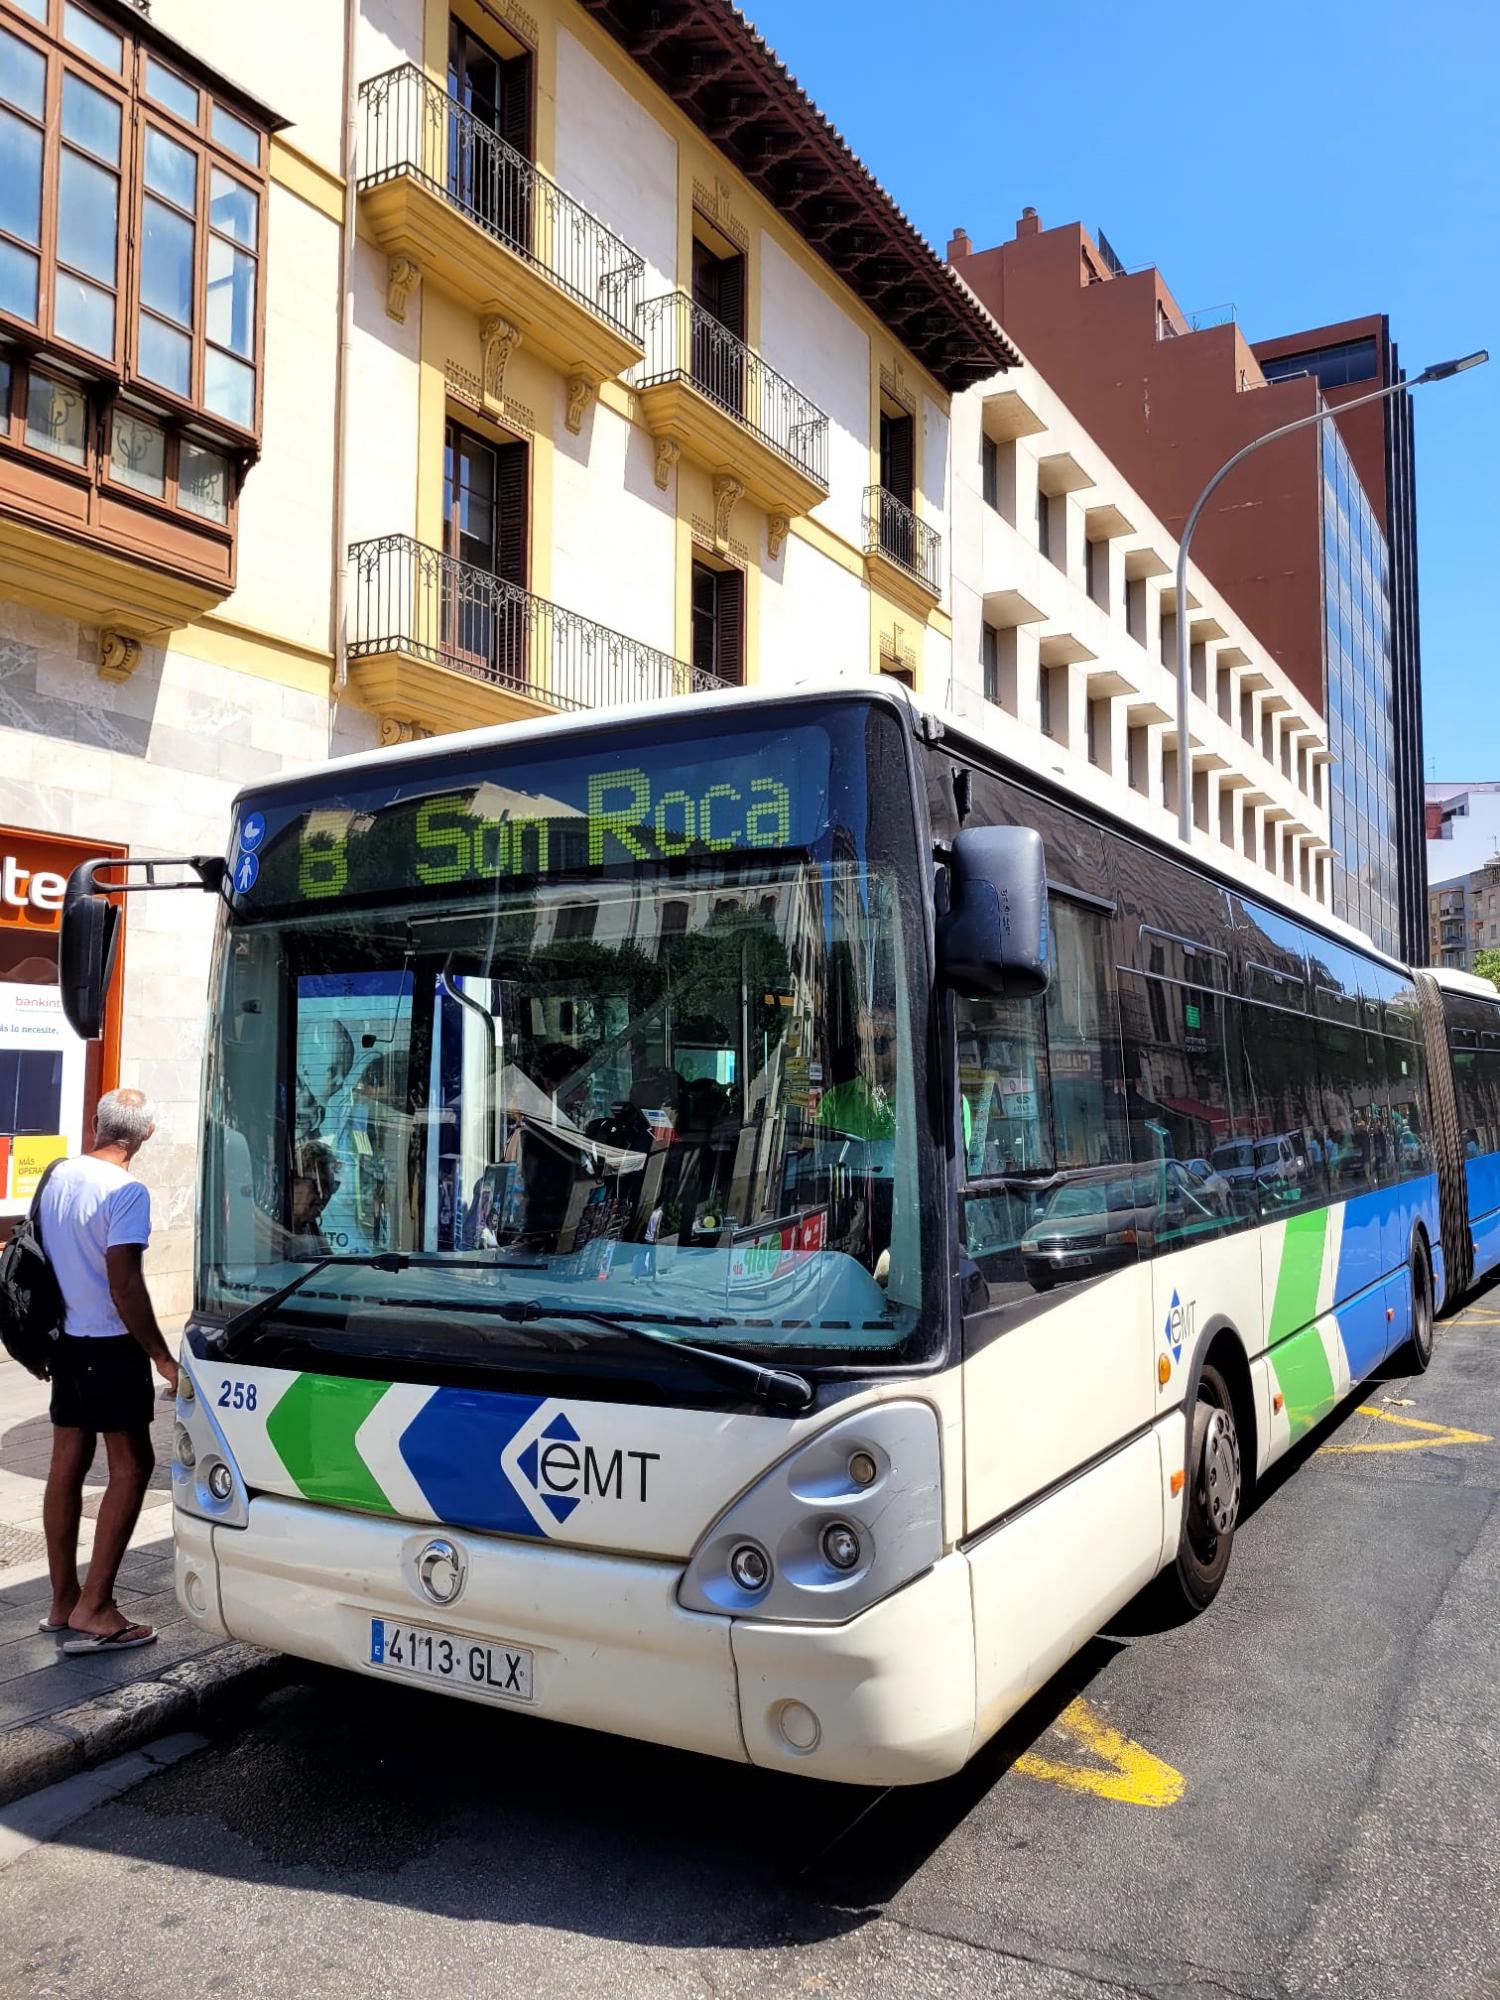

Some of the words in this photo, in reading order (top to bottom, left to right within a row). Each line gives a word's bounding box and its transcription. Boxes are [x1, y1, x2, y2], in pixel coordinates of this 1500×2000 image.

[299, 812, 348, 899] 8
[415, 795, 549, 885] Son
[588, 768, 790, 866] Roca
[0, 856, 67, 910] te
[18, 1166, 47, 1176] OPERAT
[217, 1379, 257, 1412] 258
[389, 1628, 454, 1675] 4113
[468, 1646, 521, 1692] GLX
